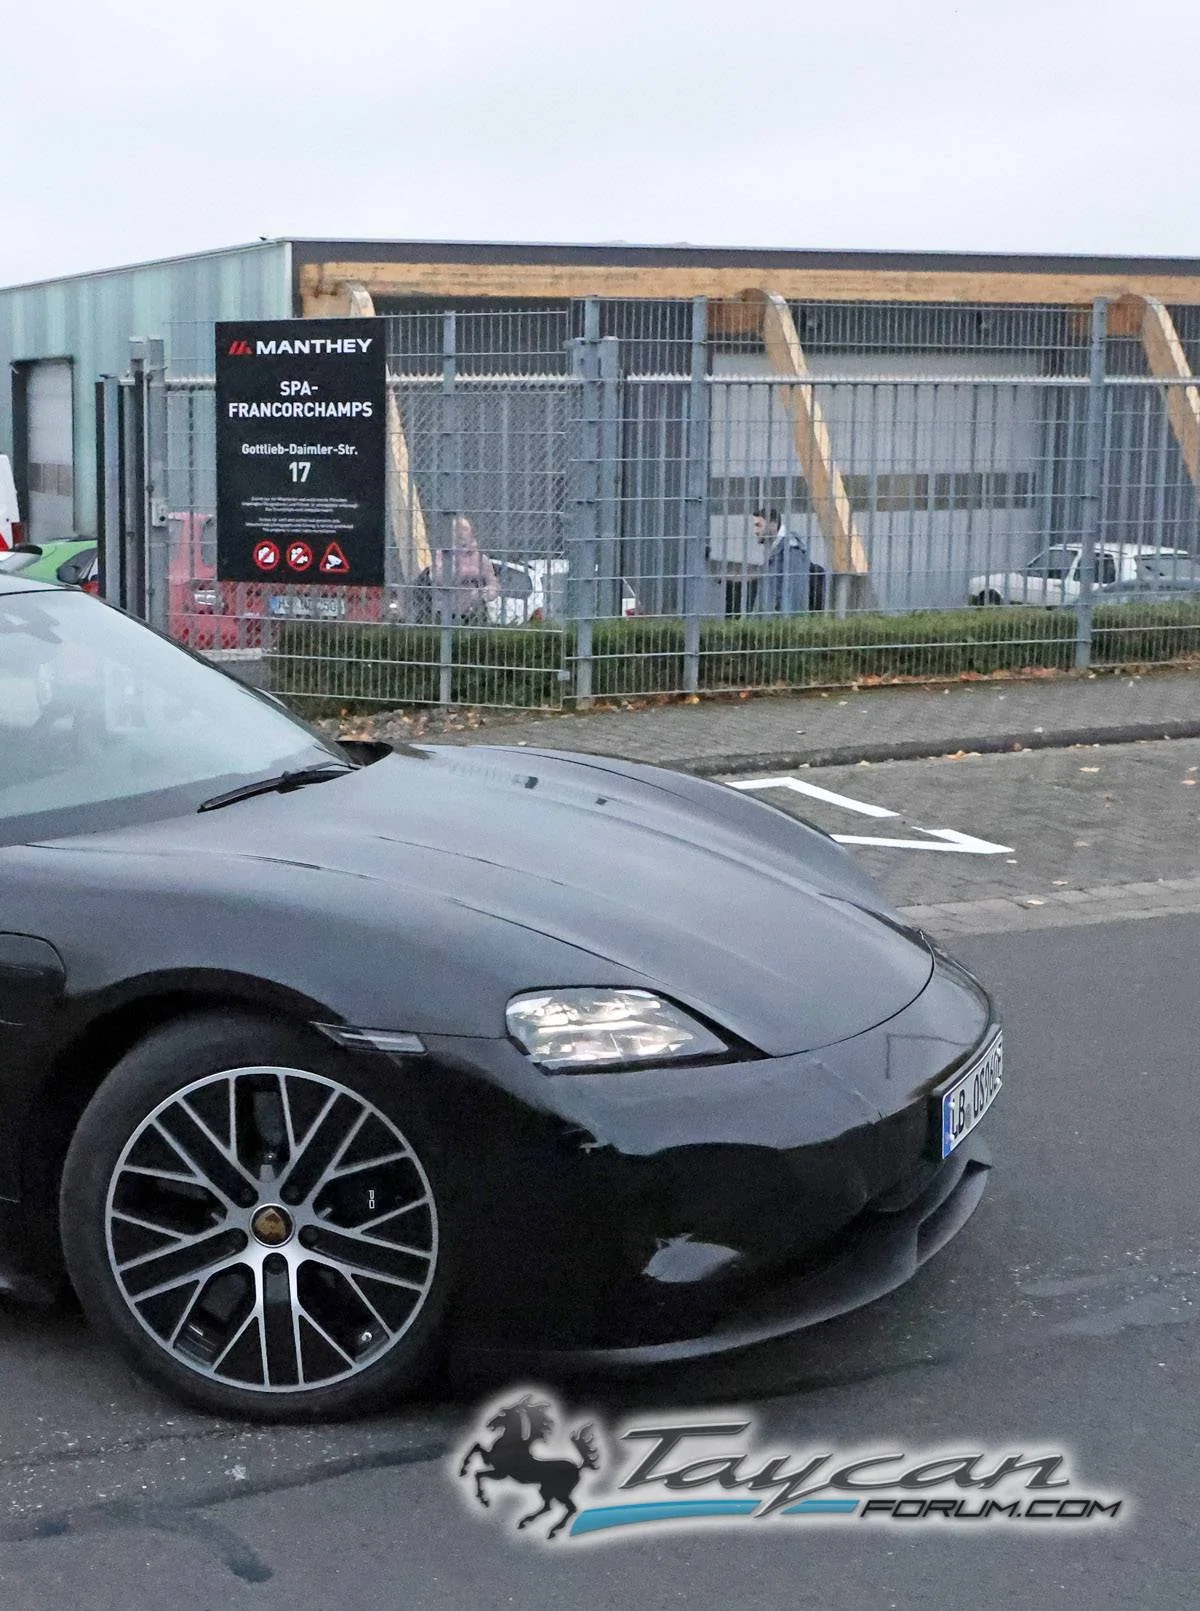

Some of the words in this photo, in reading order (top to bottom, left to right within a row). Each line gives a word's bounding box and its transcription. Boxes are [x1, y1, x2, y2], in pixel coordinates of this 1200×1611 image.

[256, 338, 373, 355] MANTHEY
[280, 380, 319, 396] SPA-
[228, 402, 373, 418] FRANCORCHAMPS
[241, 443, 359, 456] Gottlieb-Daimler-Str.
[288, 461, 312, 483] 17
